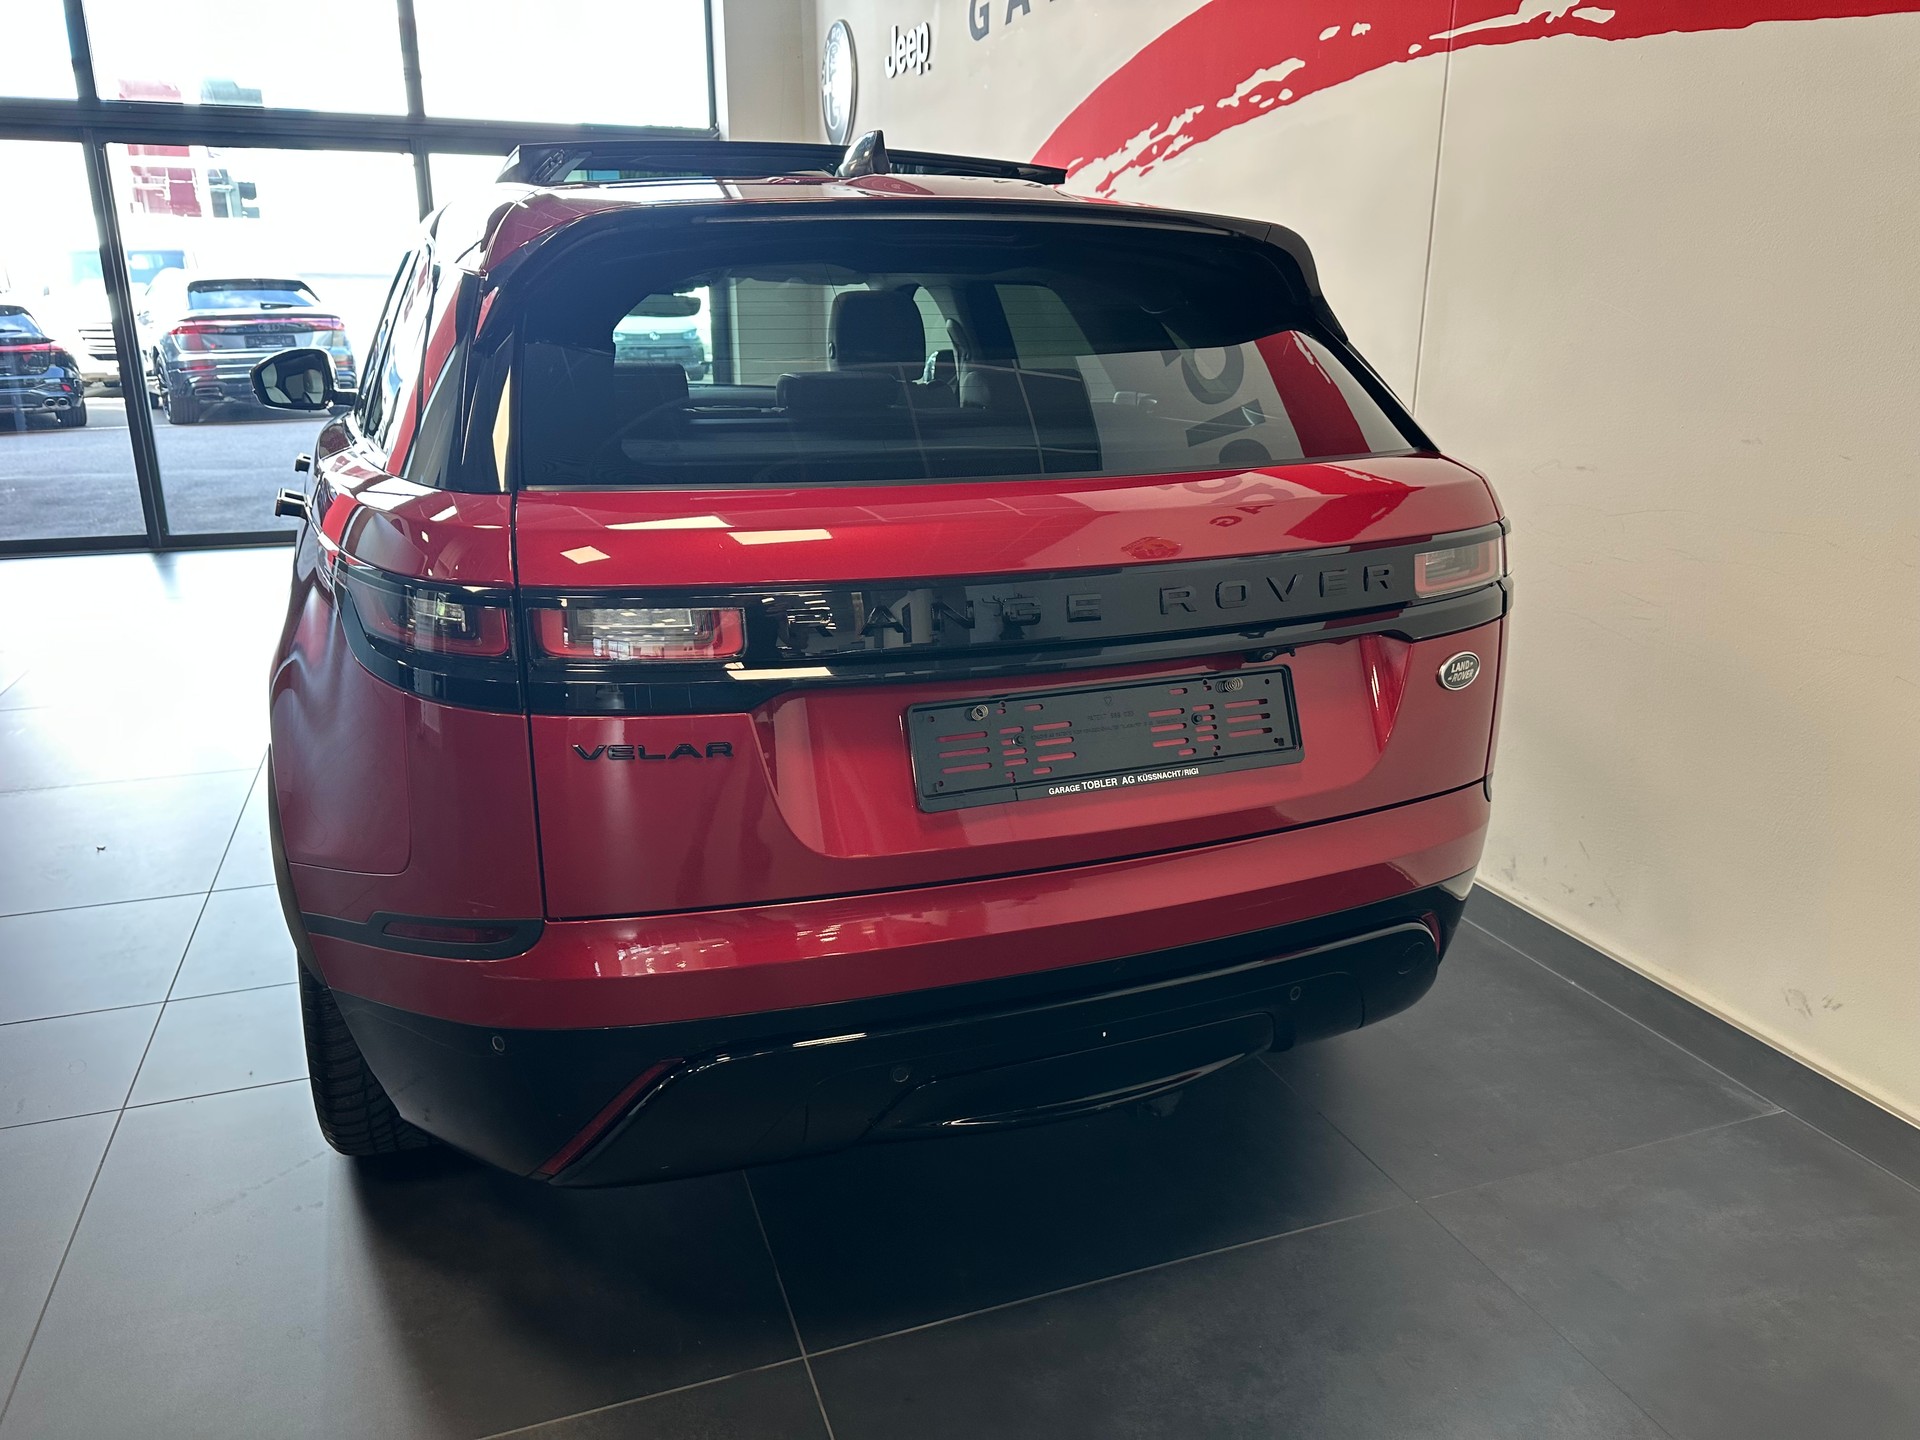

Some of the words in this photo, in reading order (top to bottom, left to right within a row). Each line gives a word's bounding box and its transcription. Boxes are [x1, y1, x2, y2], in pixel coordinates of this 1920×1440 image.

[787, 593, 1102, 637] RANGE
[1159, 564, 1395, 614] ROVER
[1451, 660, 1471, 674] LAND
[1451, 668, 1474, 683] ROVER
[571, 741, 734, 761] VELAR
[1048, 784, 1081, 795] GARAGE
[1081, 777, 1118, 791] TOBLER
[1121, 775, 1135, 786] AG
[1137, 767, 1199, 783] KÜSSNACHT/RIGI
